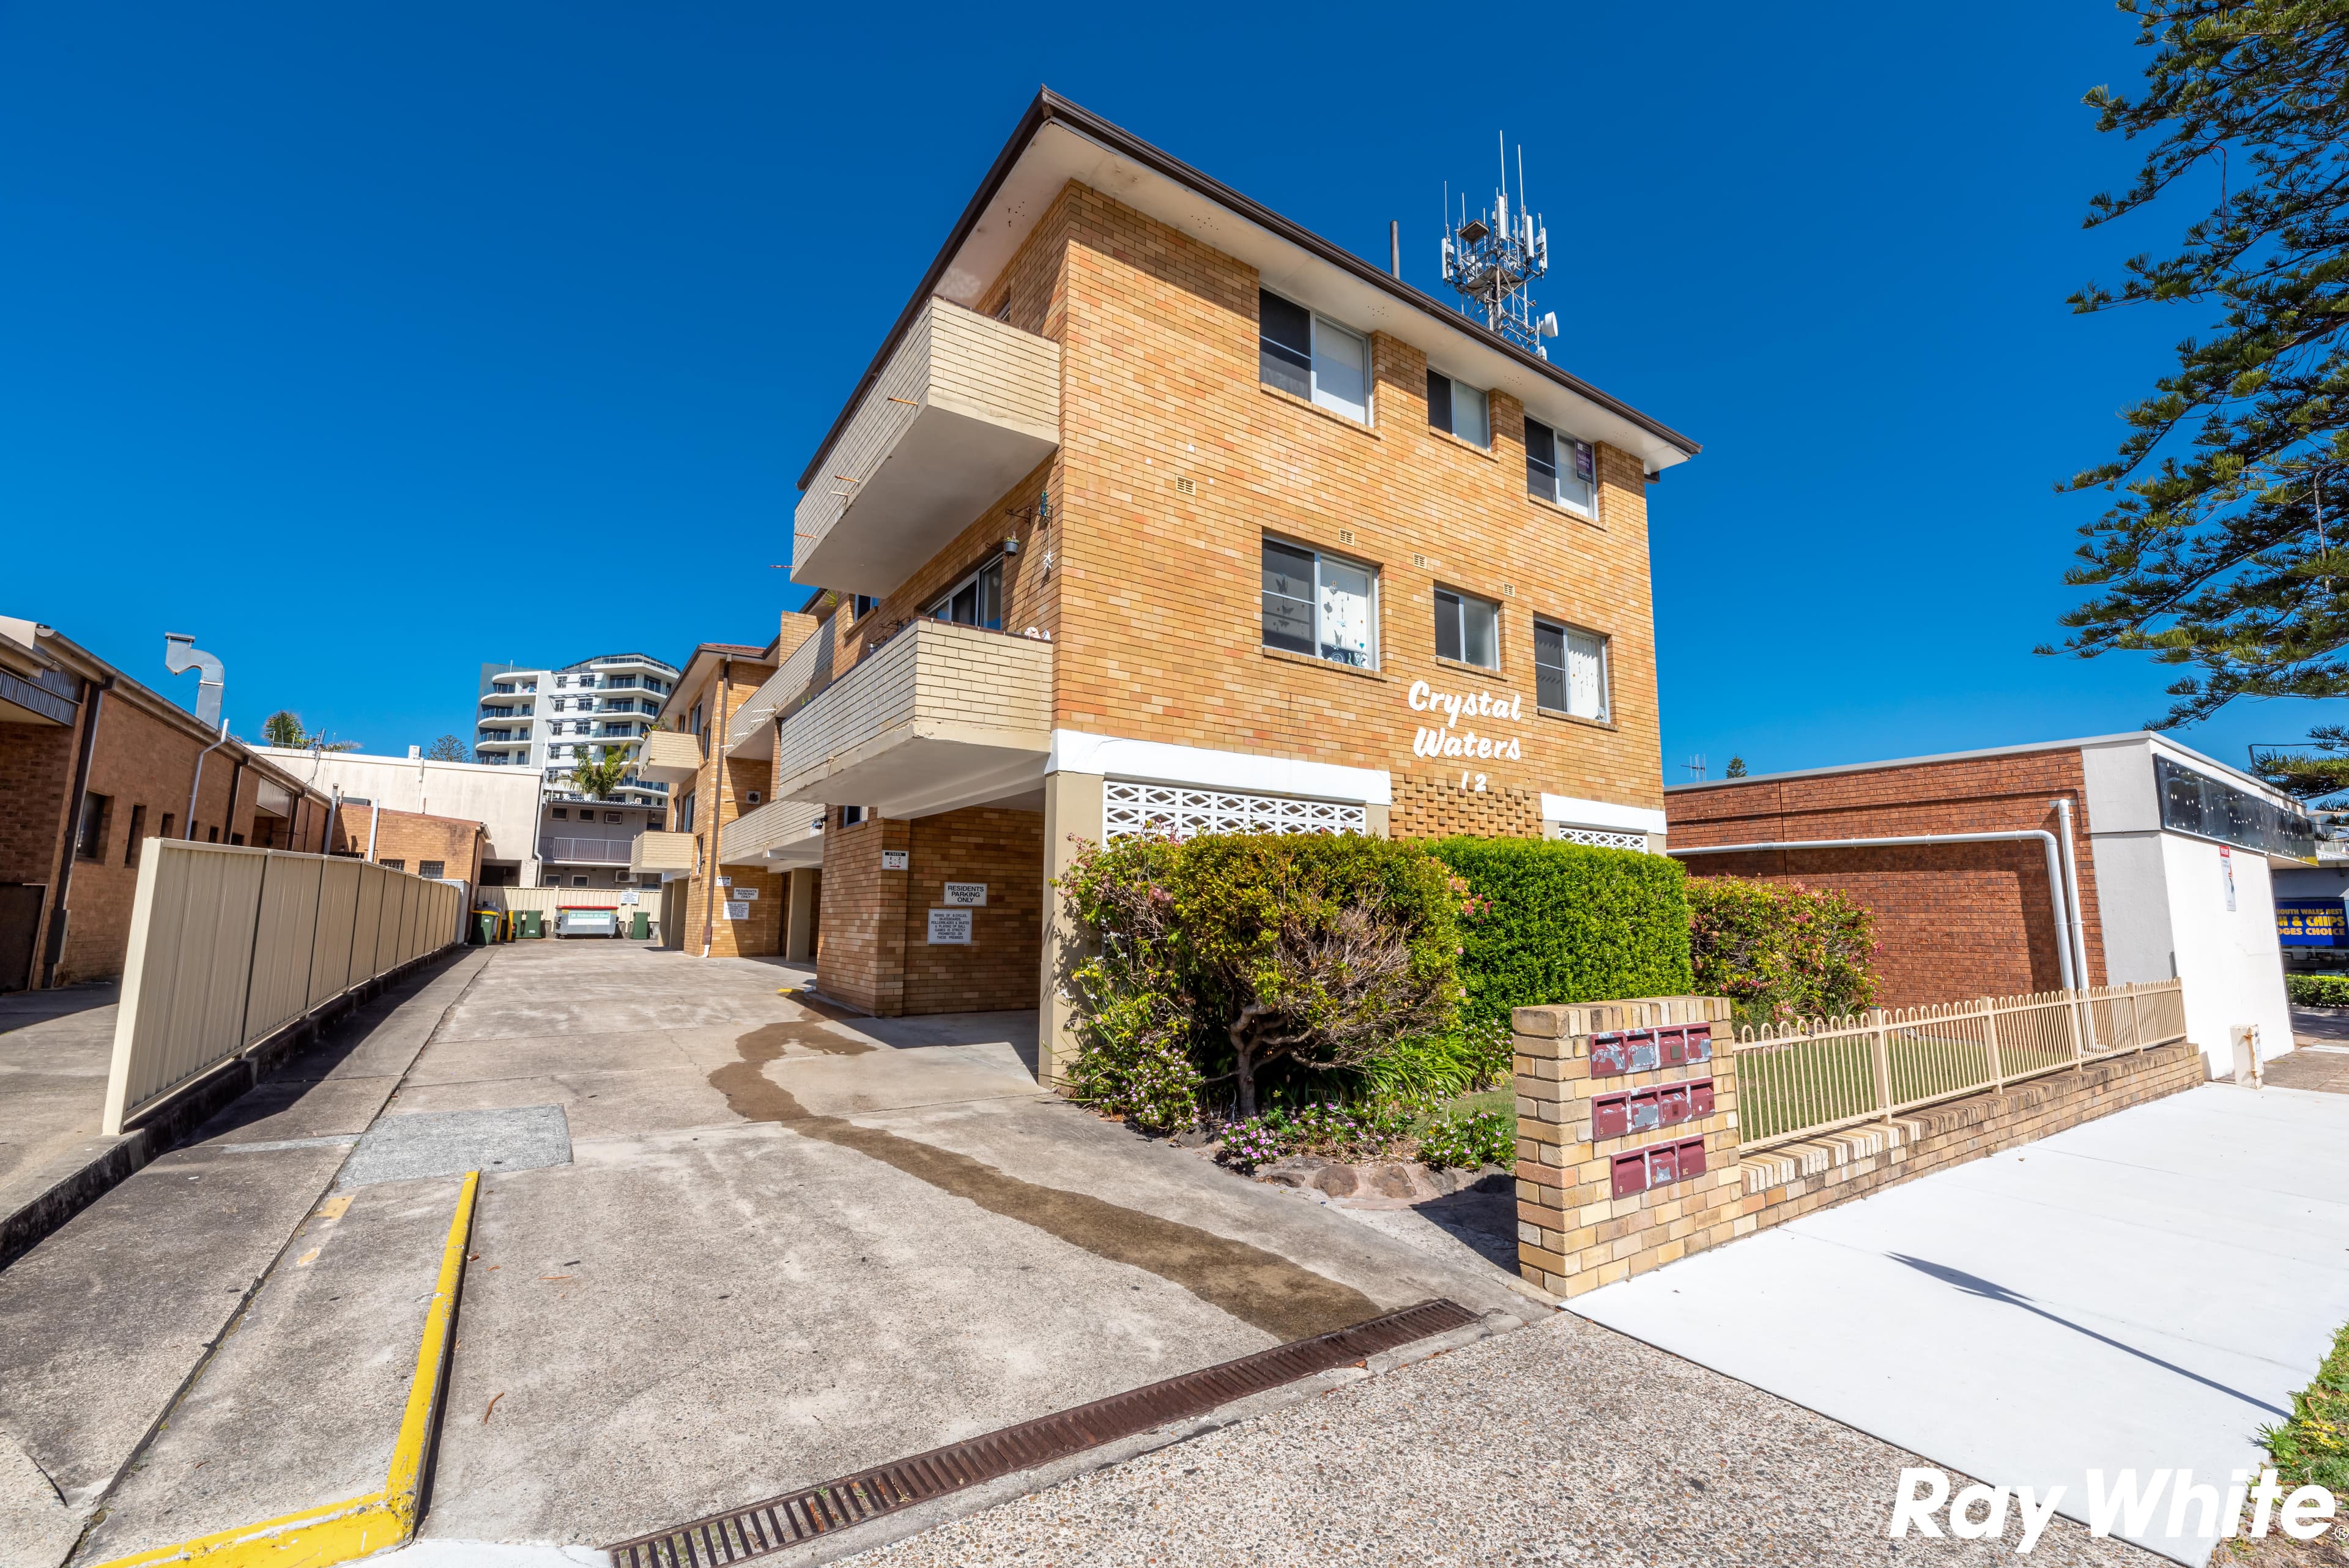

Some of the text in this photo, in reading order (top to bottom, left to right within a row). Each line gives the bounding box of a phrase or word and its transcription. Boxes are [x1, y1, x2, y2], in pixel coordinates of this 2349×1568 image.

[1408, 680, 1522, 729] Crystal
[1413, 727, 1521, 760] Waters
[2291, 916, 2303, 926] &
[2306, 916, 2345, 926] CHIPS
